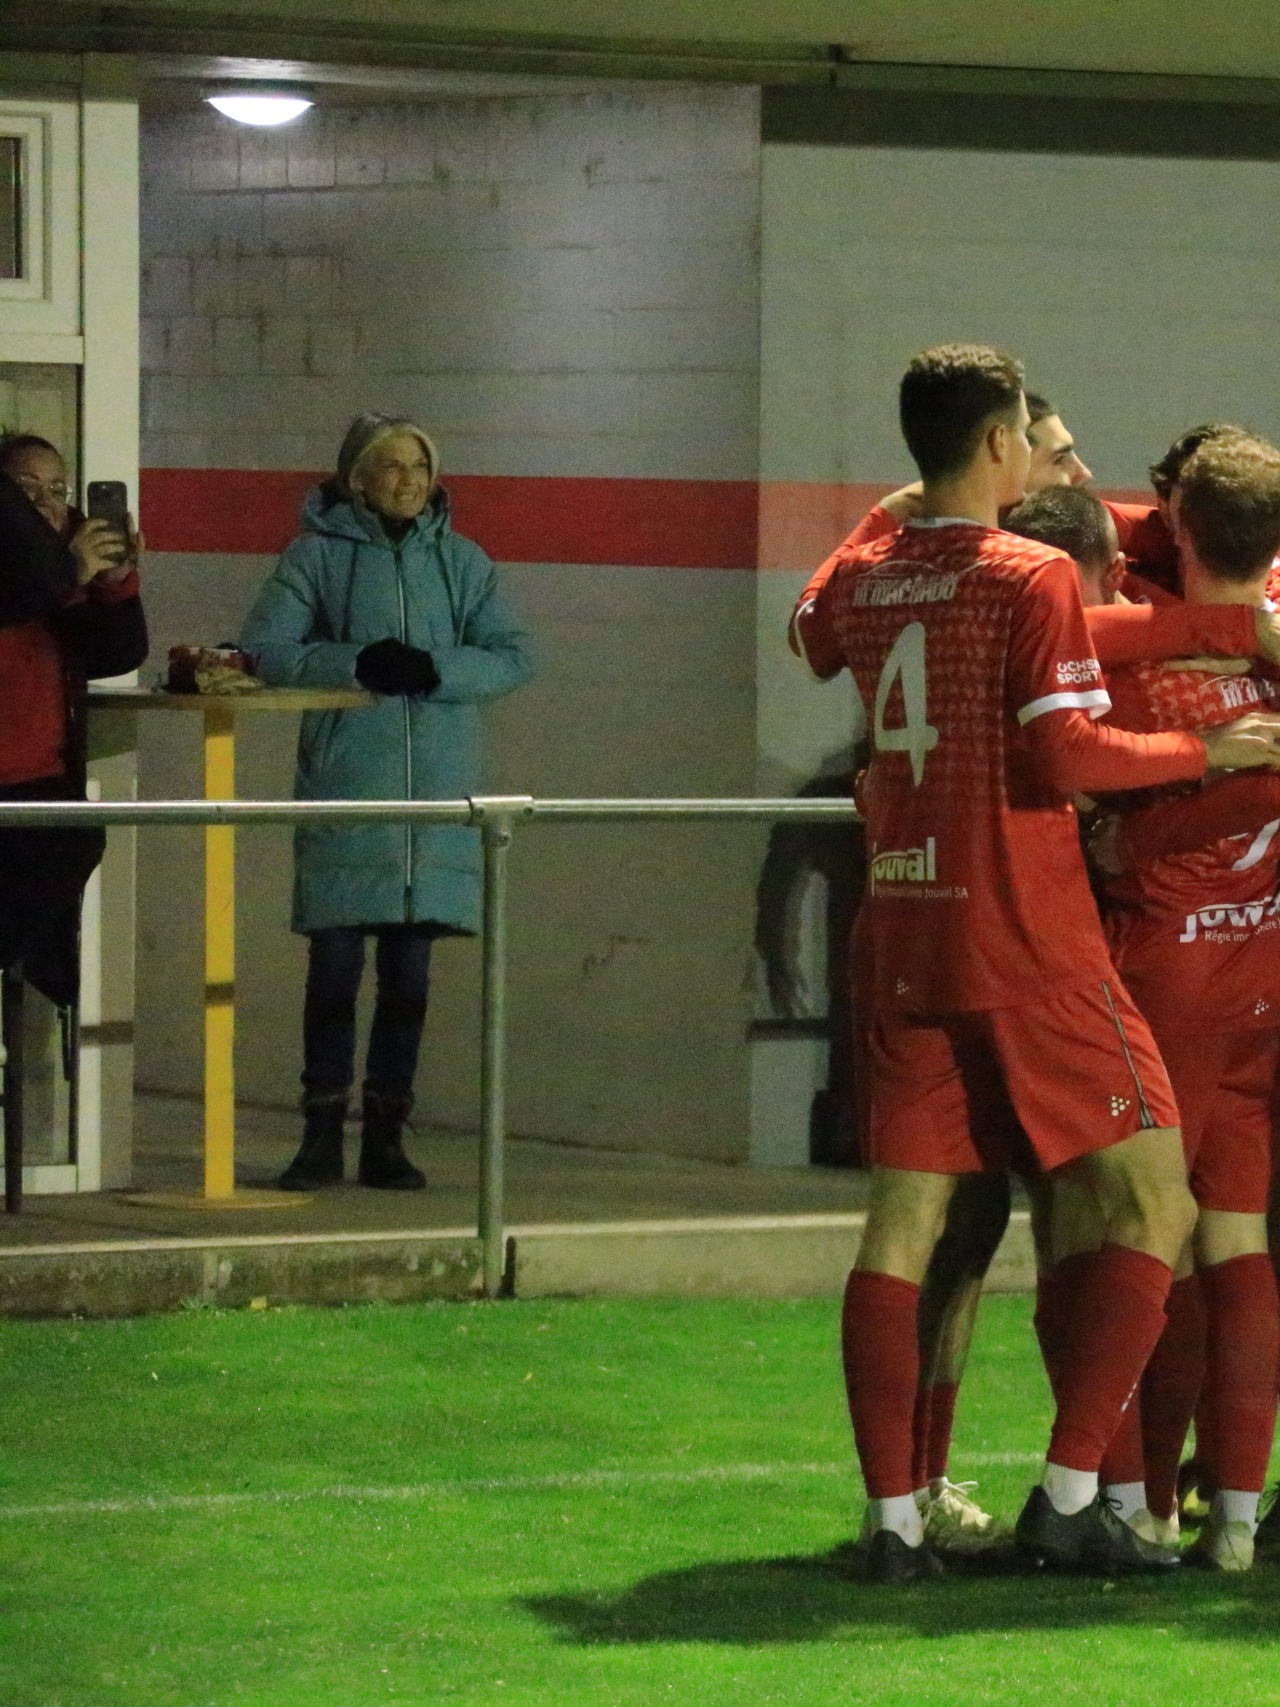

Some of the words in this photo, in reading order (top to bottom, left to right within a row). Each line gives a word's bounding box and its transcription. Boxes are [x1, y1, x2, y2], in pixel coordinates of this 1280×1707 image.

[1056, 670, 1100, 684] SPORT
[874, 621, 940, 787] 4
[955, 887, 968, 898] SA
